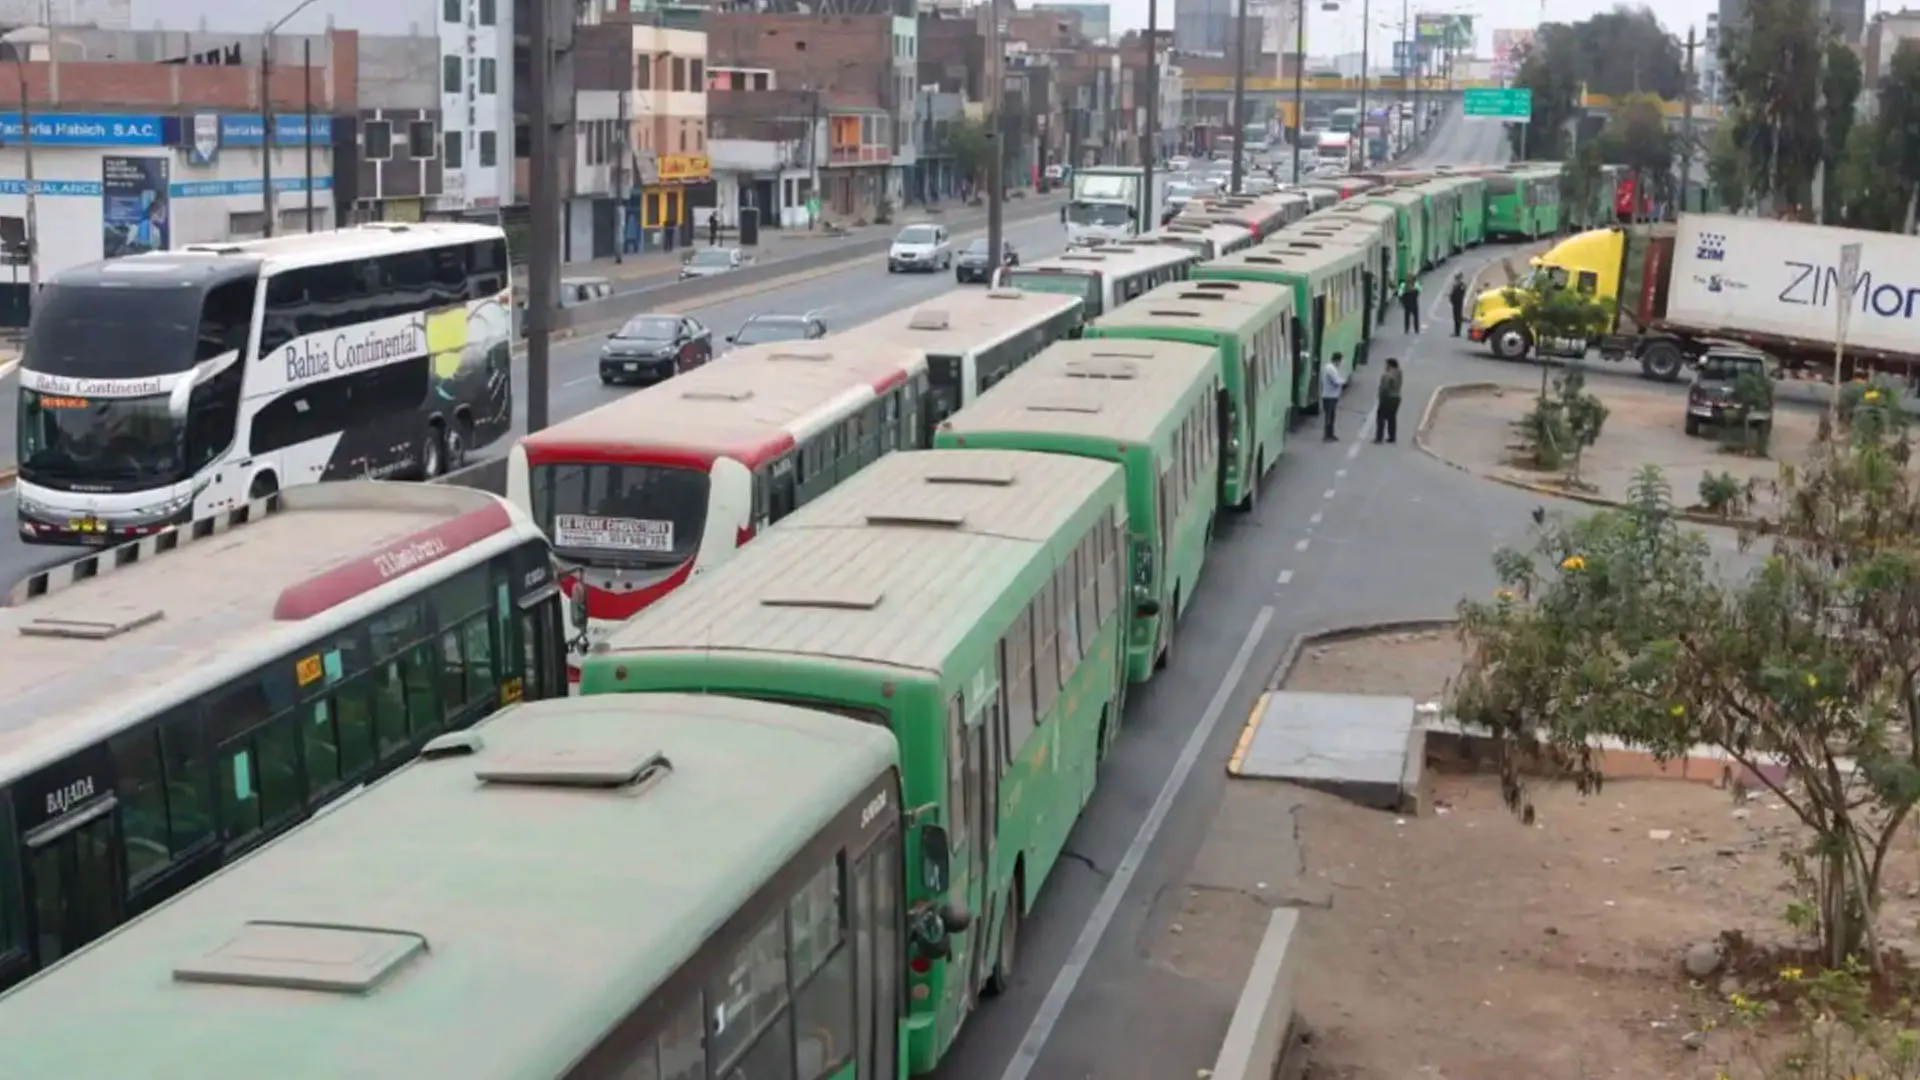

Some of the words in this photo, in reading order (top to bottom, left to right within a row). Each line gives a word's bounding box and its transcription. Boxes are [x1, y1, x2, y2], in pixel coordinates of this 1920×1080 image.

[1696, 246, 1726, 261] ZIM
[286, 339, 330, 382] Bahia
[334, 316, 417, 370] Continental
[76, 378, 161, 394] Continental
[46, 775, 95, 814] BAJADA
